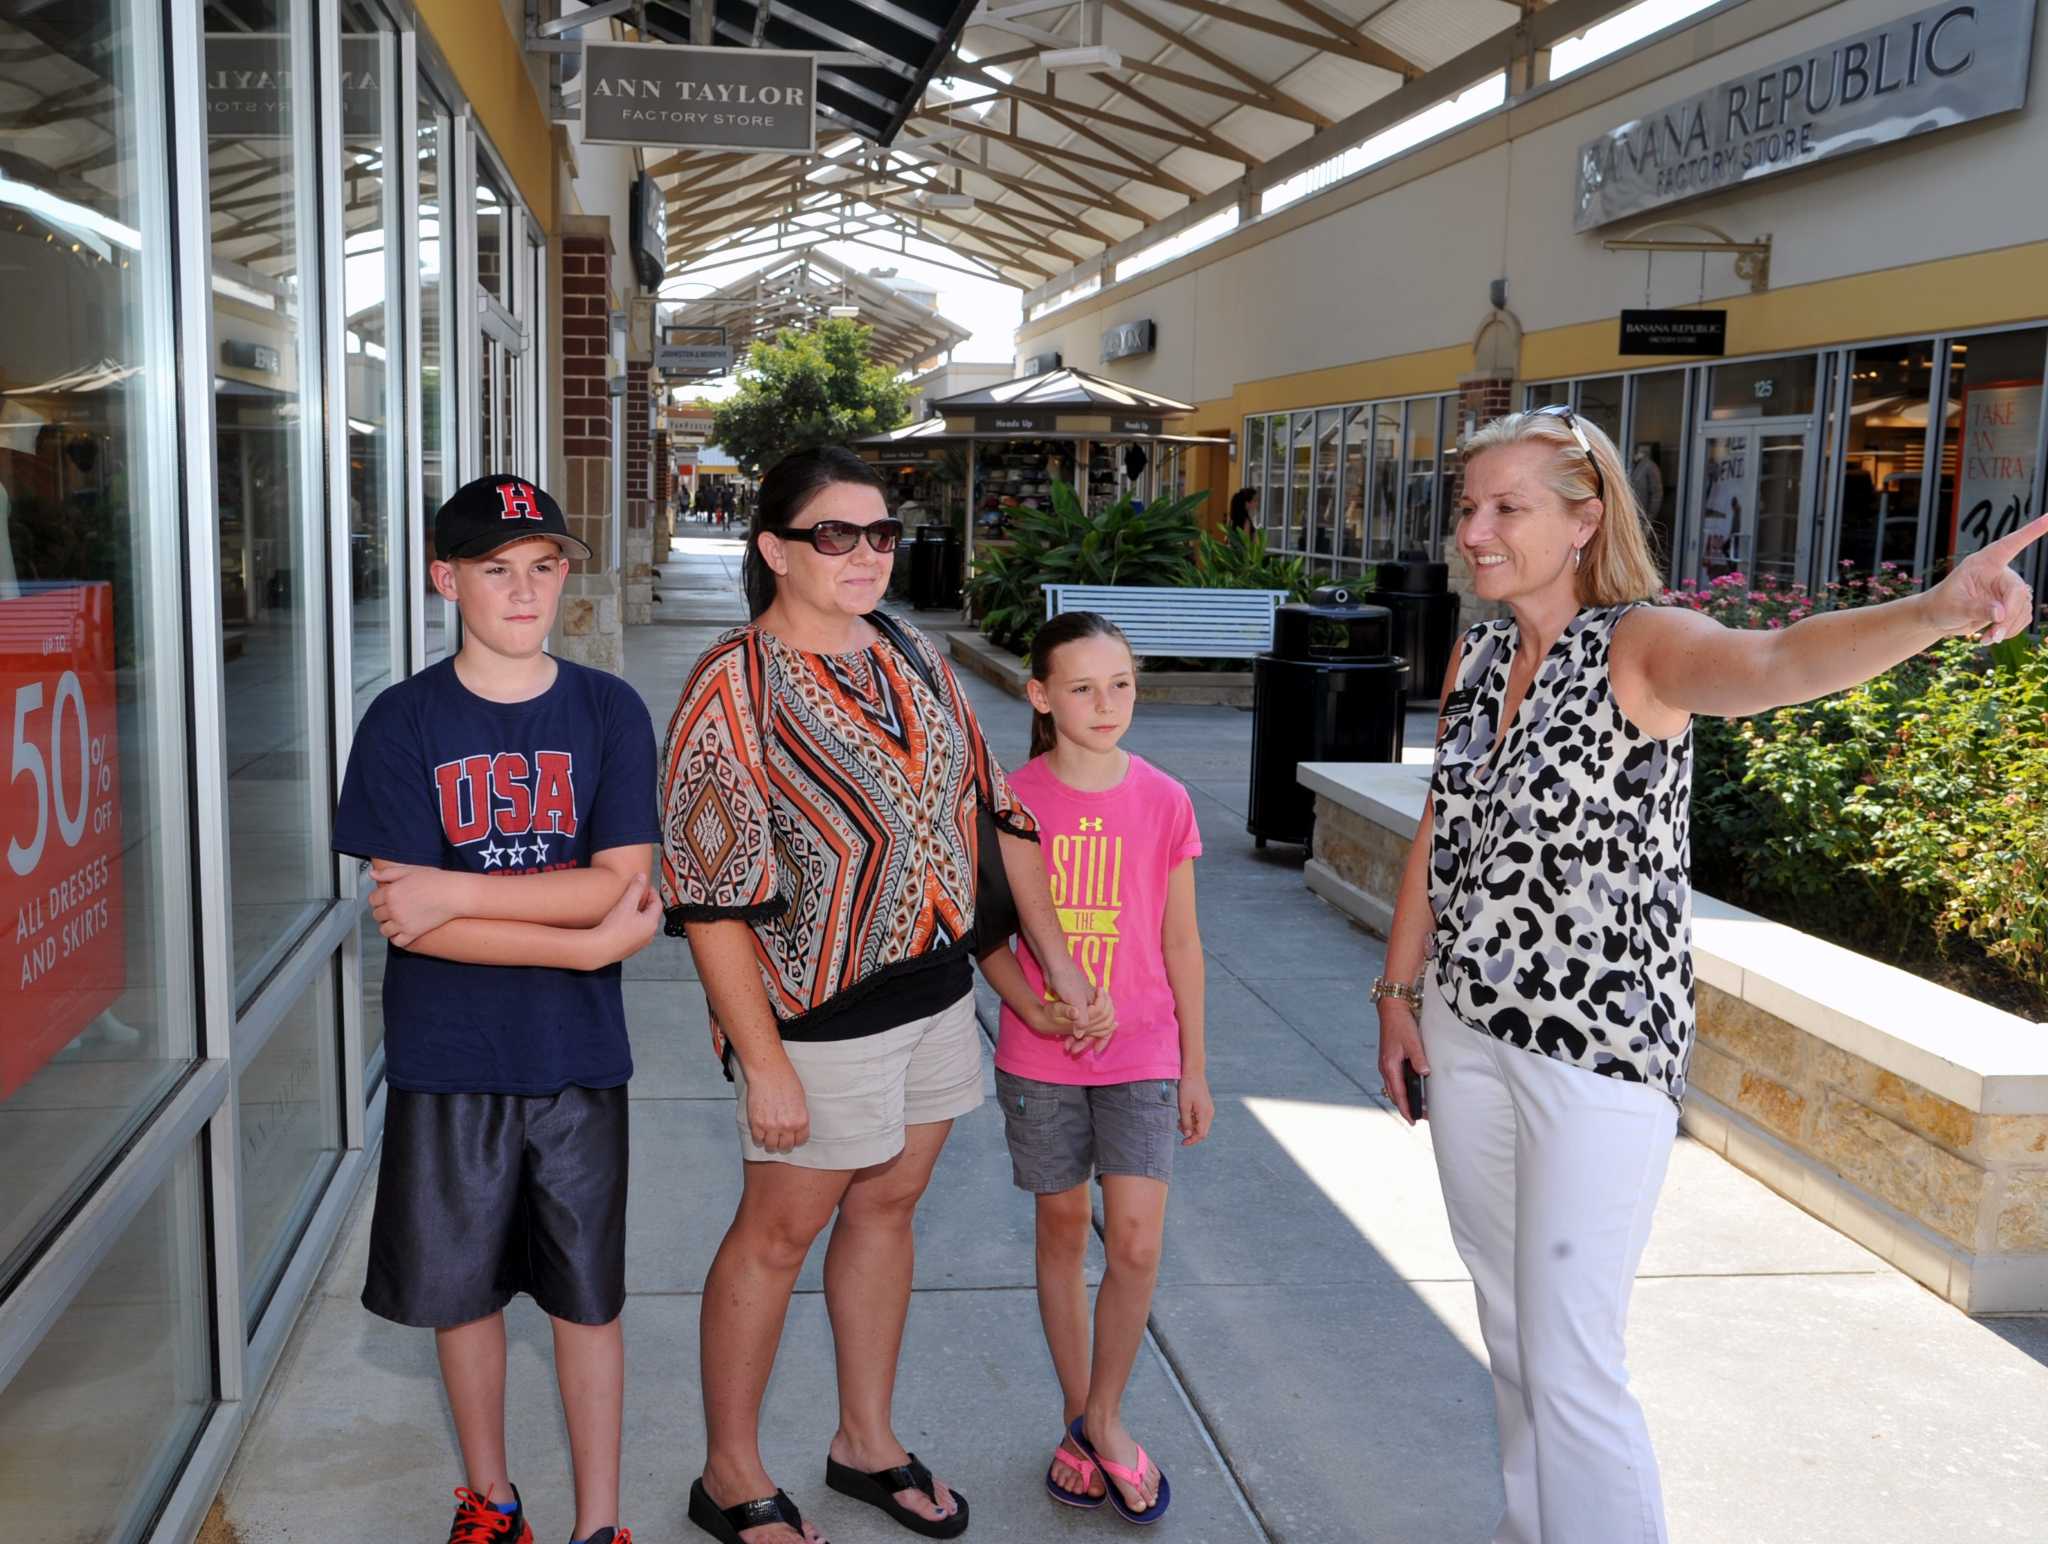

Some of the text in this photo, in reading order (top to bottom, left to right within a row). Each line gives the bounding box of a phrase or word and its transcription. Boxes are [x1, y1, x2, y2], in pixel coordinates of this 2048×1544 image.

[593, 77, 806, 106] ANN TAYLOR
[1584, 6, 1977, 190] ANANA REPUBLIC
[622, 108, 775, 127] FACTORY STORE
[1656, 122, 1816, 197] FACTORY STORE
[1625, 323, 1721, 334] BANANA REPUBLIC
[1754, 380, 1773, 398] 125
[1972, 401, 2016, 426] TAKE
[1973, 430, 1995, 451] AN
[1967, 456, 2025, 480] EXTRA
[495, 482, 544, 520] H
[434, 750, 578, 847] USA
[93, 801, 113, 834] OFF
[1050, 834, 1123, 907] STILL
[16, 855, 109, 944] ALL DRESSES
[1074, 911, 1096, 931] THE
[20, 898, 108, 992] AND SKIRTS
